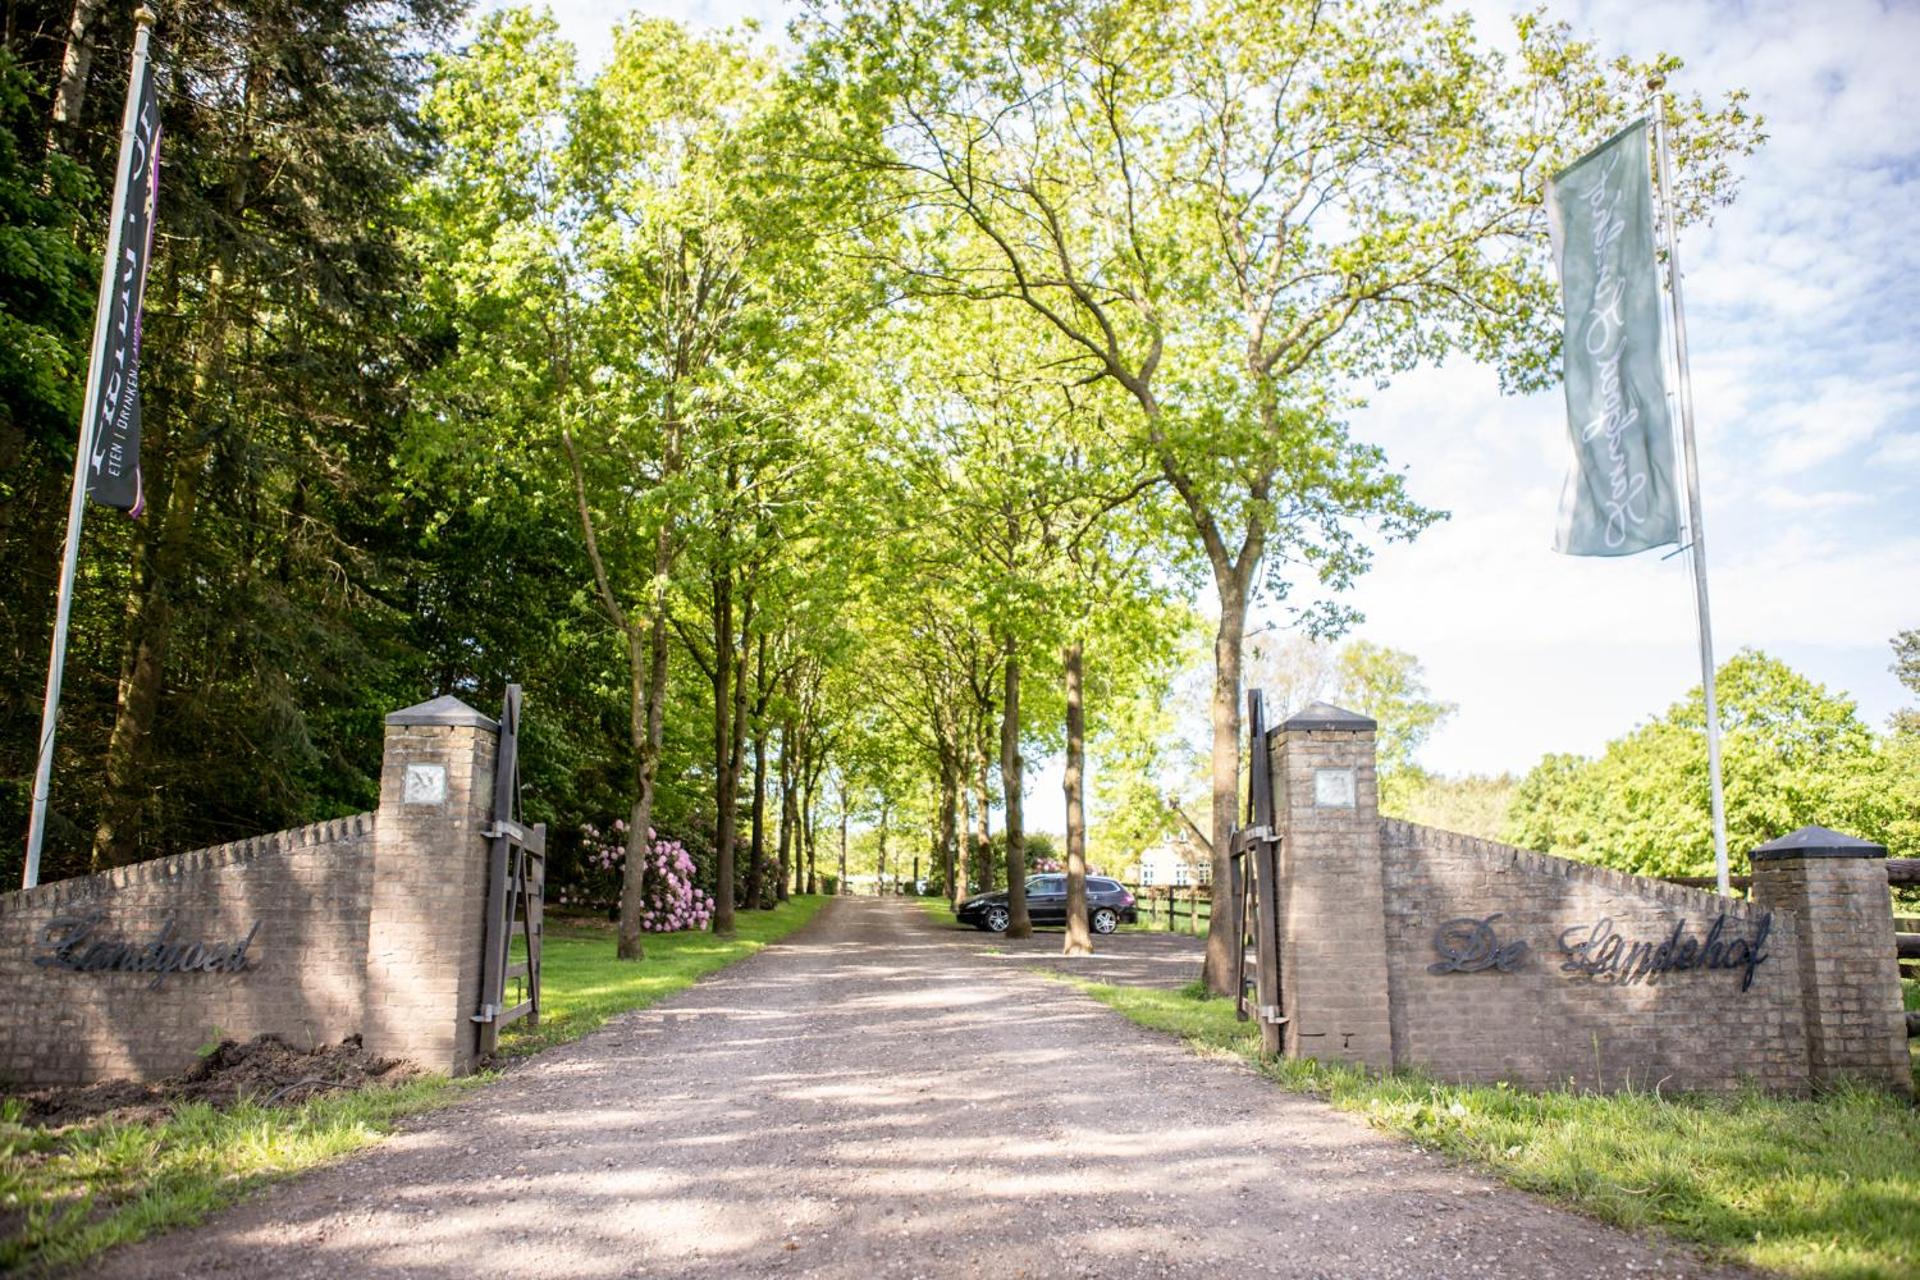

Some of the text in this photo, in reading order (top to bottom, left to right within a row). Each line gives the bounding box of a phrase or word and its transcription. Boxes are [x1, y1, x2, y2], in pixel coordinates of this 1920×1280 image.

[108, 442, 124, 477] ETEN
[116, 368, 139, 430] DRINKEN
[1427, 913, 1529, 974] De
